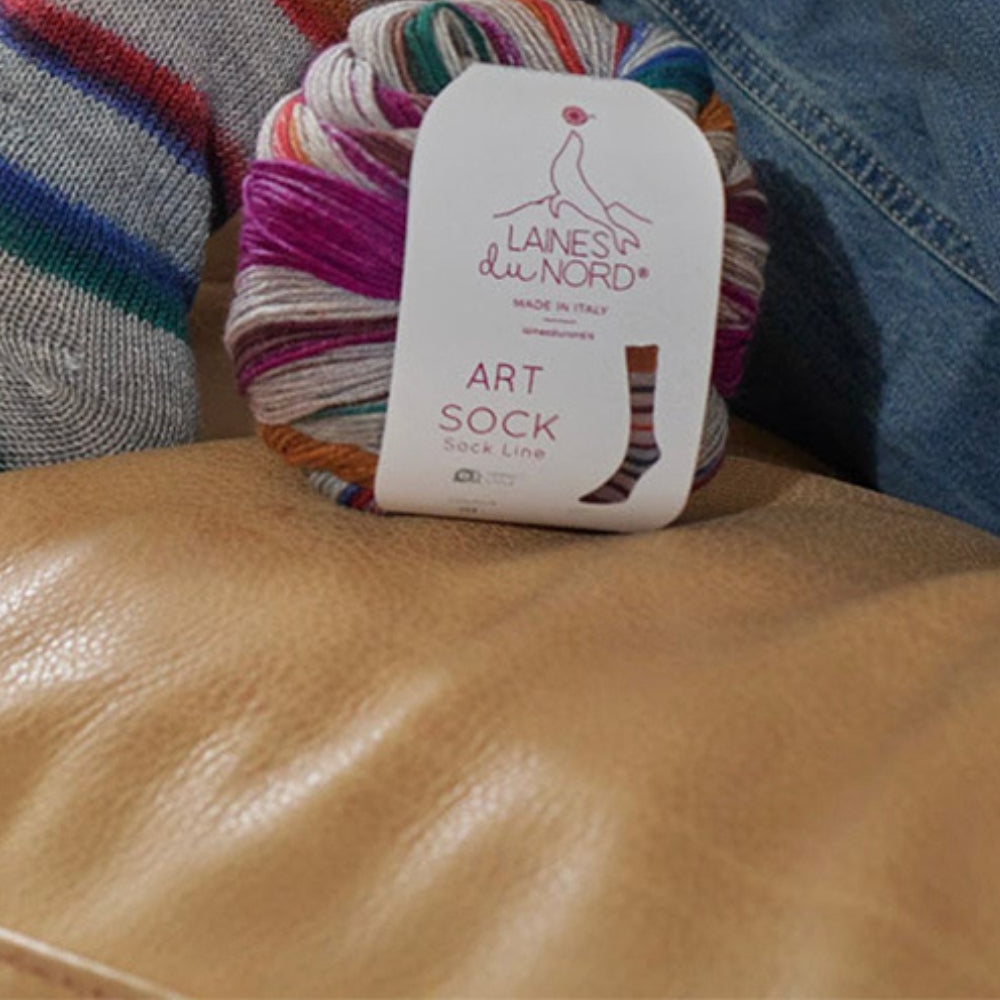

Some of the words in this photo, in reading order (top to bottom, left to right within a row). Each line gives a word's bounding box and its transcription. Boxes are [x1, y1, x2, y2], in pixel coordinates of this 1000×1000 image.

[507, 224, 610, 260] LAINES
[479, 242, 538, 282] du
[512, 298, 551, 312] MADE
[556, 301, 570, 313] IN
[573, 302, 609, 316] ITALY
[465, 361, 544, 395] ART
[438, 403, 559, 441] SOCK
[443, 437, 492, 455] Sock
[501, 443, 546, 459] Line
